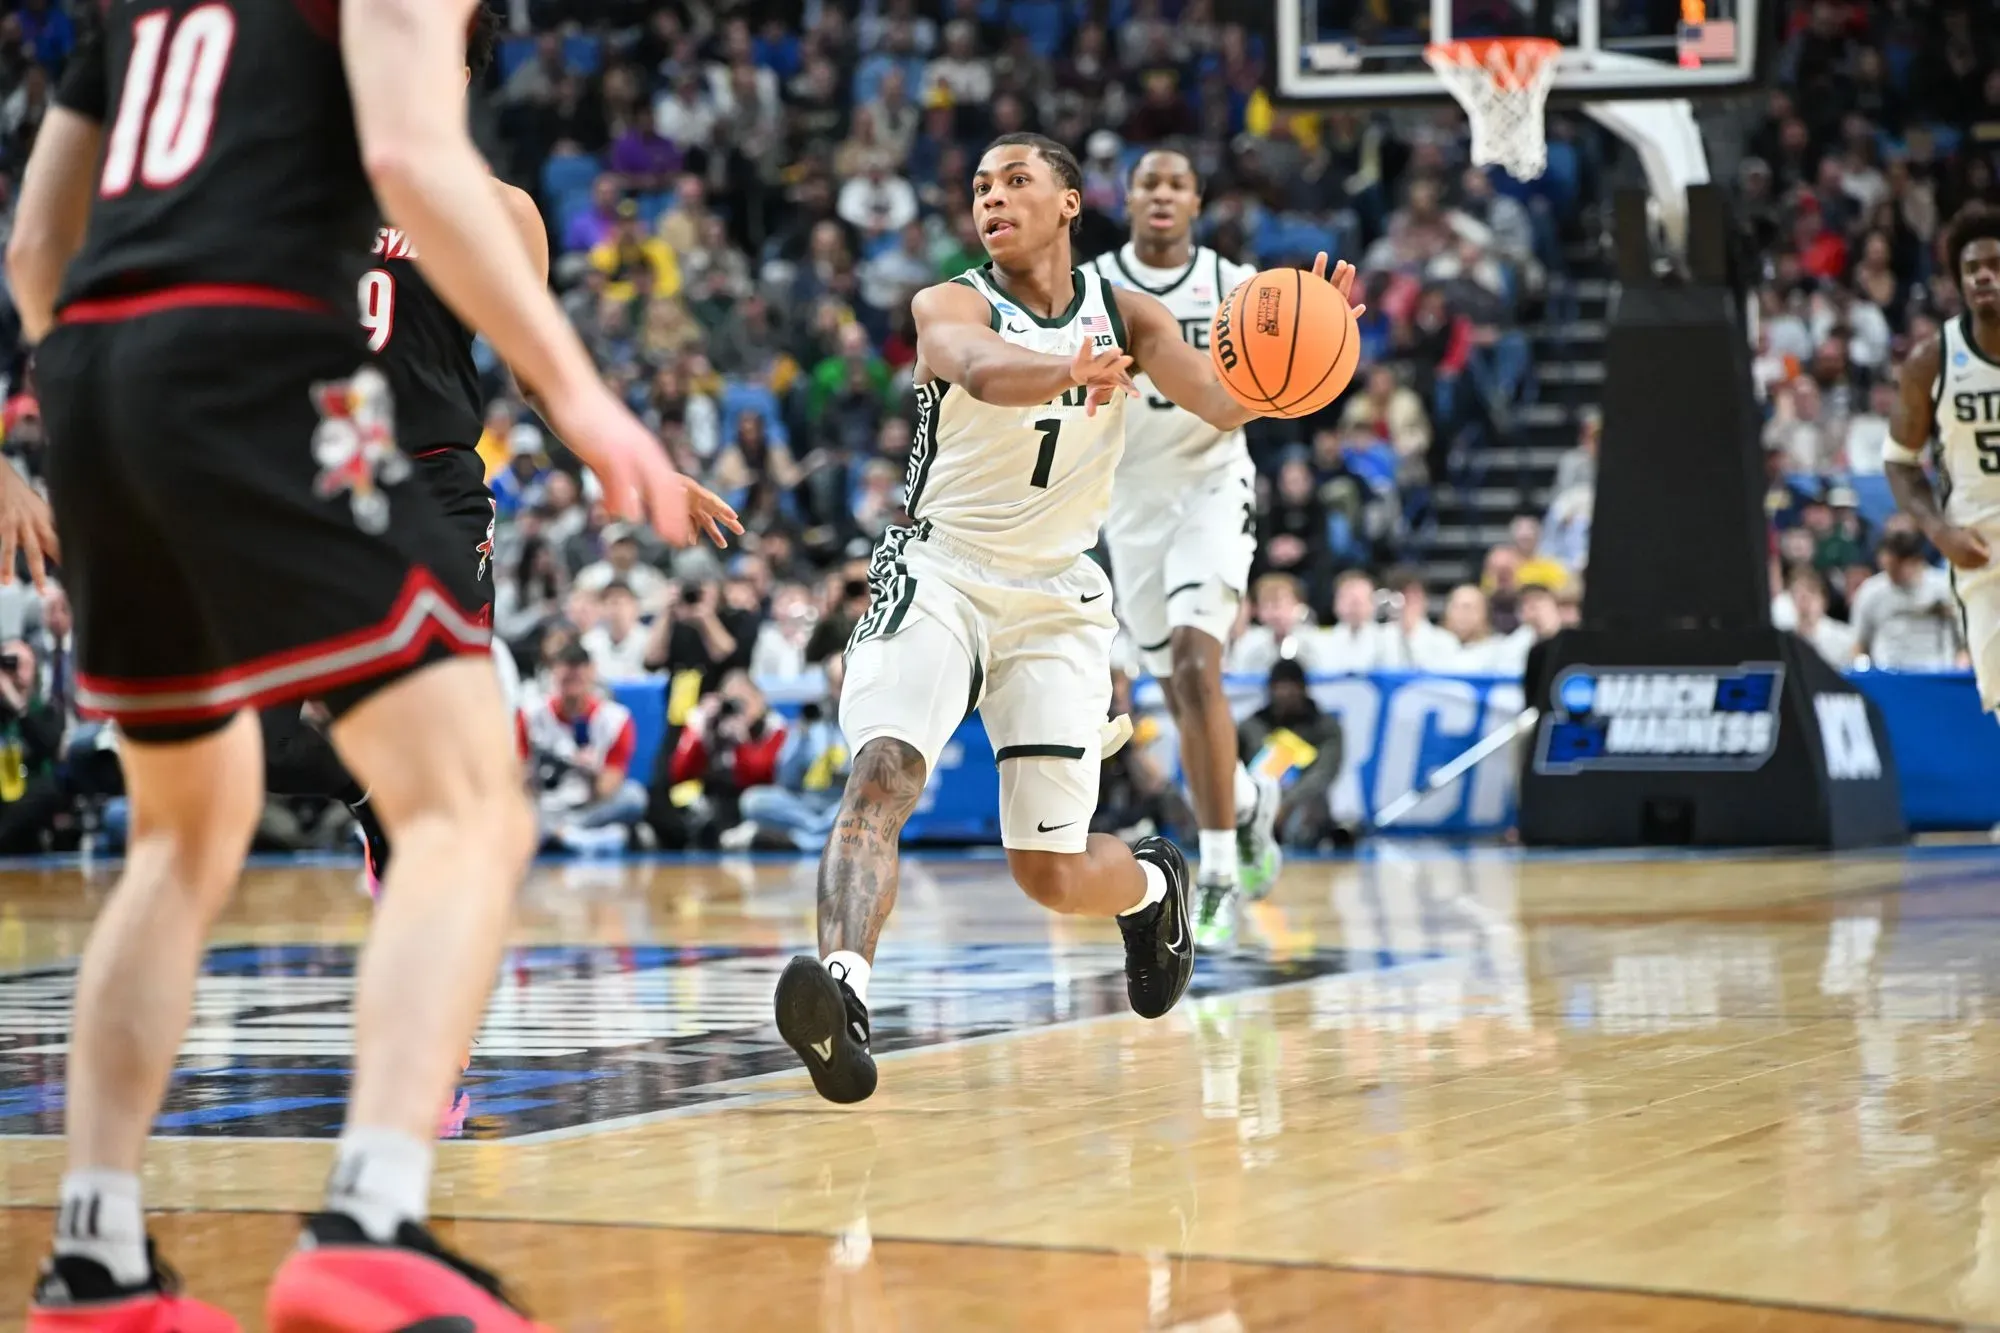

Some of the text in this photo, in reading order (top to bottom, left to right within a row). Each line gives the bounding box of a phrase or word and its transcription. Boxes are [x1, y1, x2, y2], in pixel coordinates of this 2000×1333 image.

[101, 4, 236, 198] 10
[1954, 390, 2000, 423] ST
[1030, 418, 1061, 489] 1
[1974, 430, 2000, 475] 5
